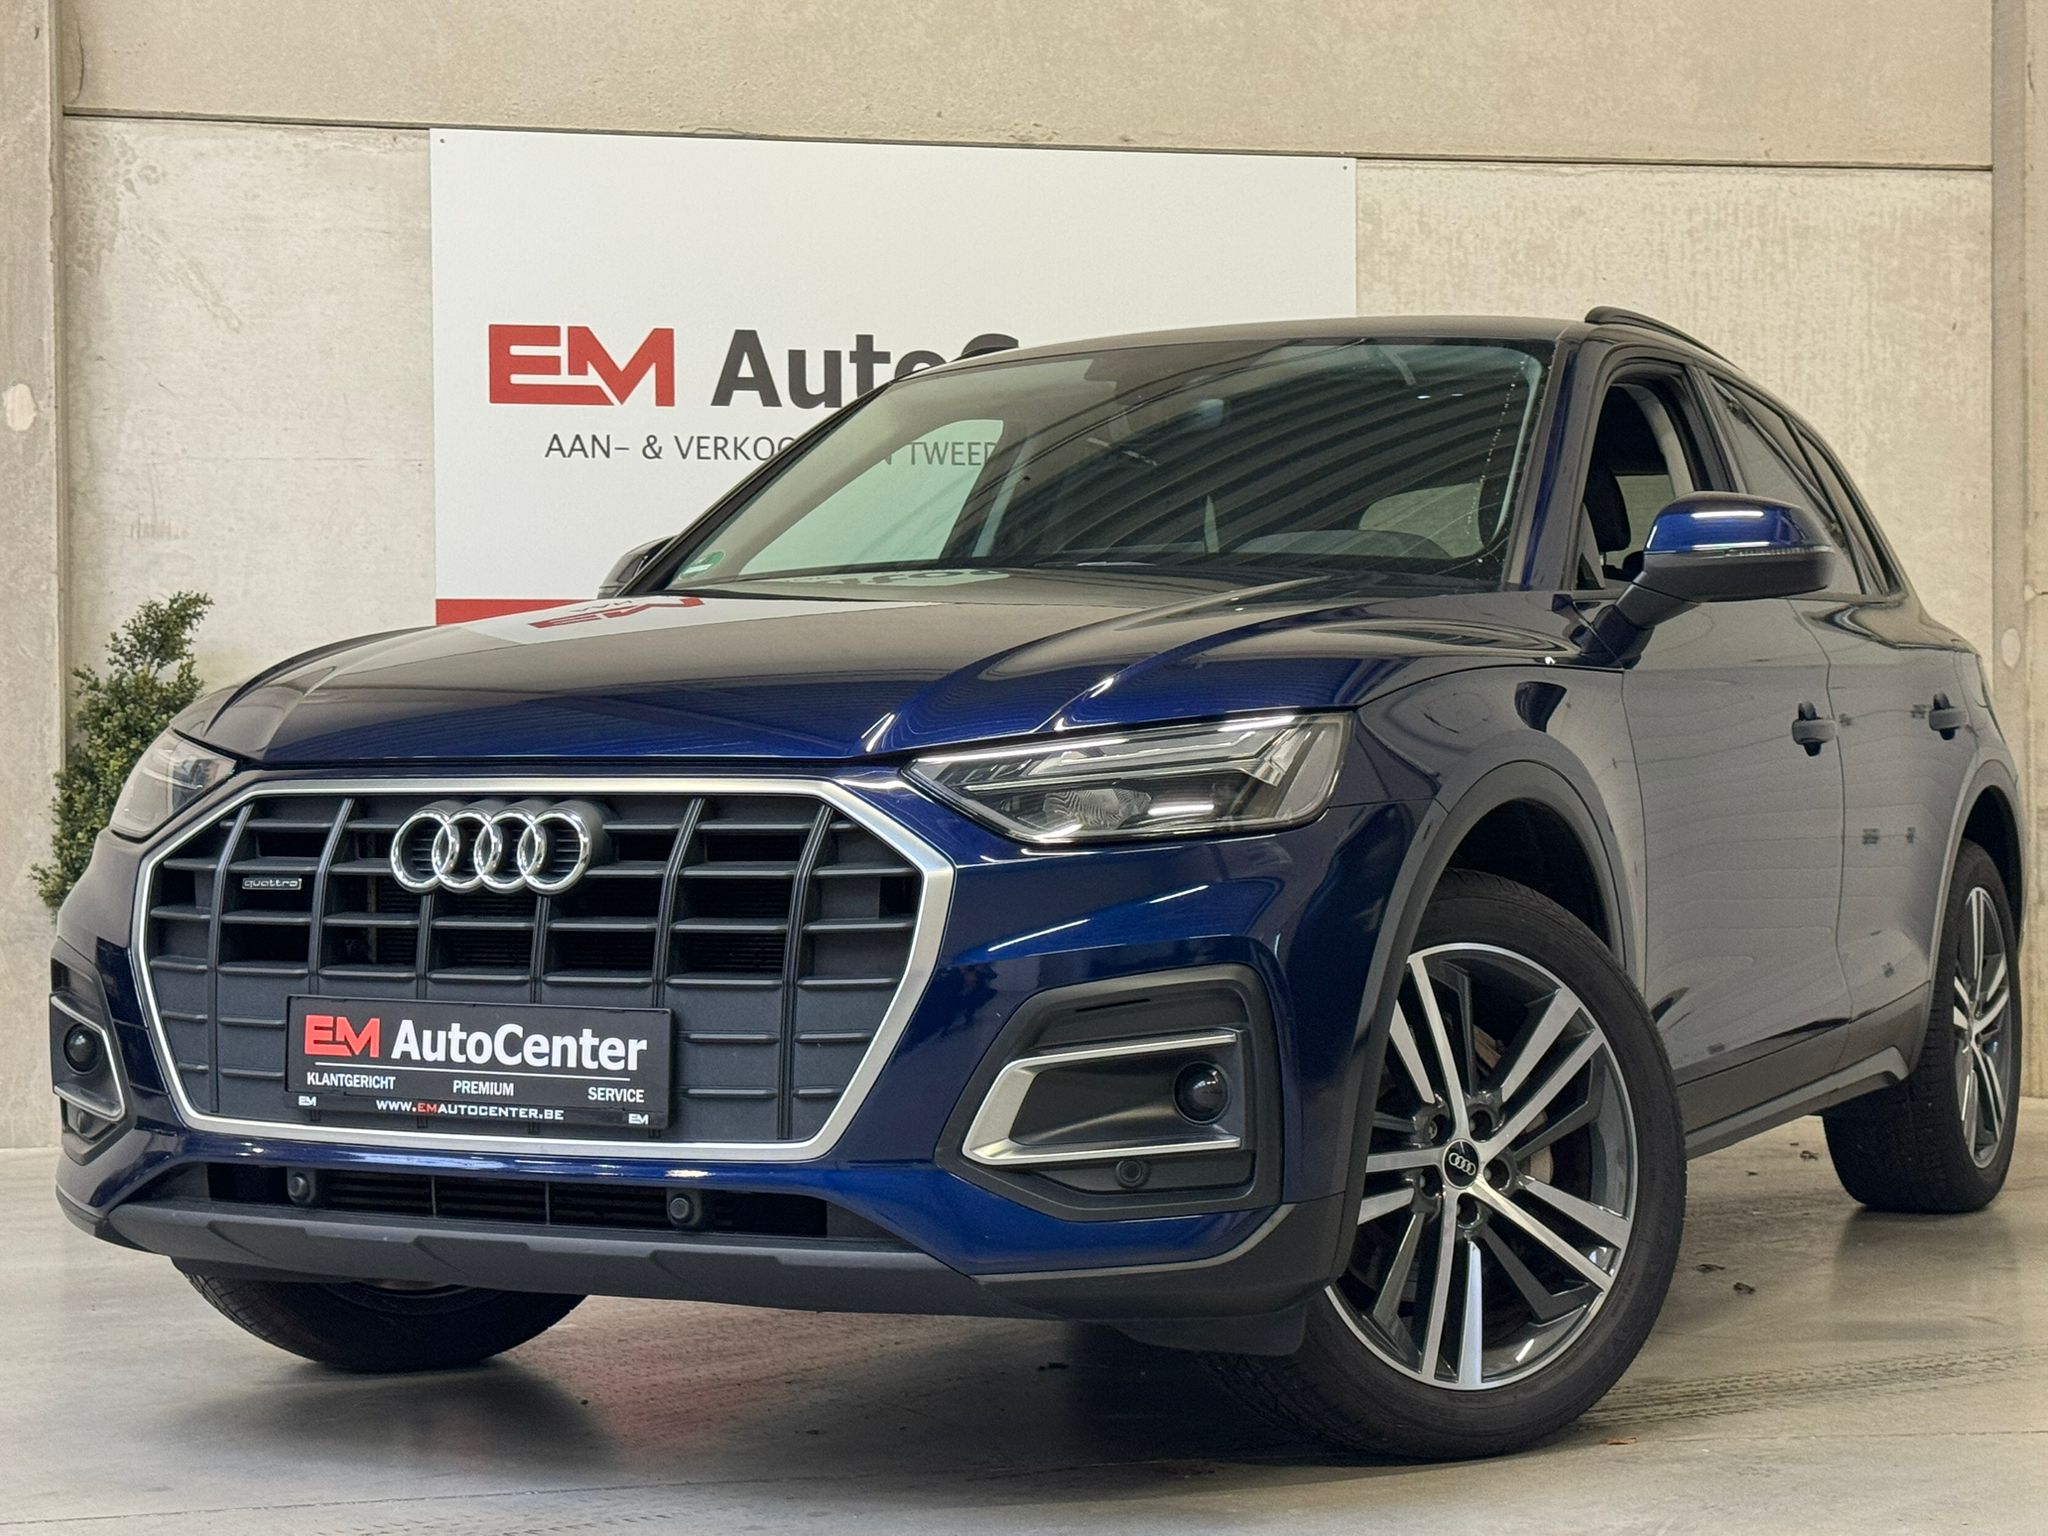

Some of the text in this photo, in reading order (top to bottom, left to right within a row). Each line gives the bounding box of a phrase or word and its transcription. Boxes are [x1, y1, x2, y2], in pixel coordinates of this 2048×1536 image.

[488, 323, 675, 407] EM
[641, 433, 663, 460] &
[244, 879, 298, 888] quattro
[304, 1014, 647, 1072] EM AutoCenter
[306, 1071, 645, 1103] KLANTGERICHT PREMIUM SERVICE
[298, 1095, 649, 1126] EM WWW.EMAUTOCENTER.BE EM
